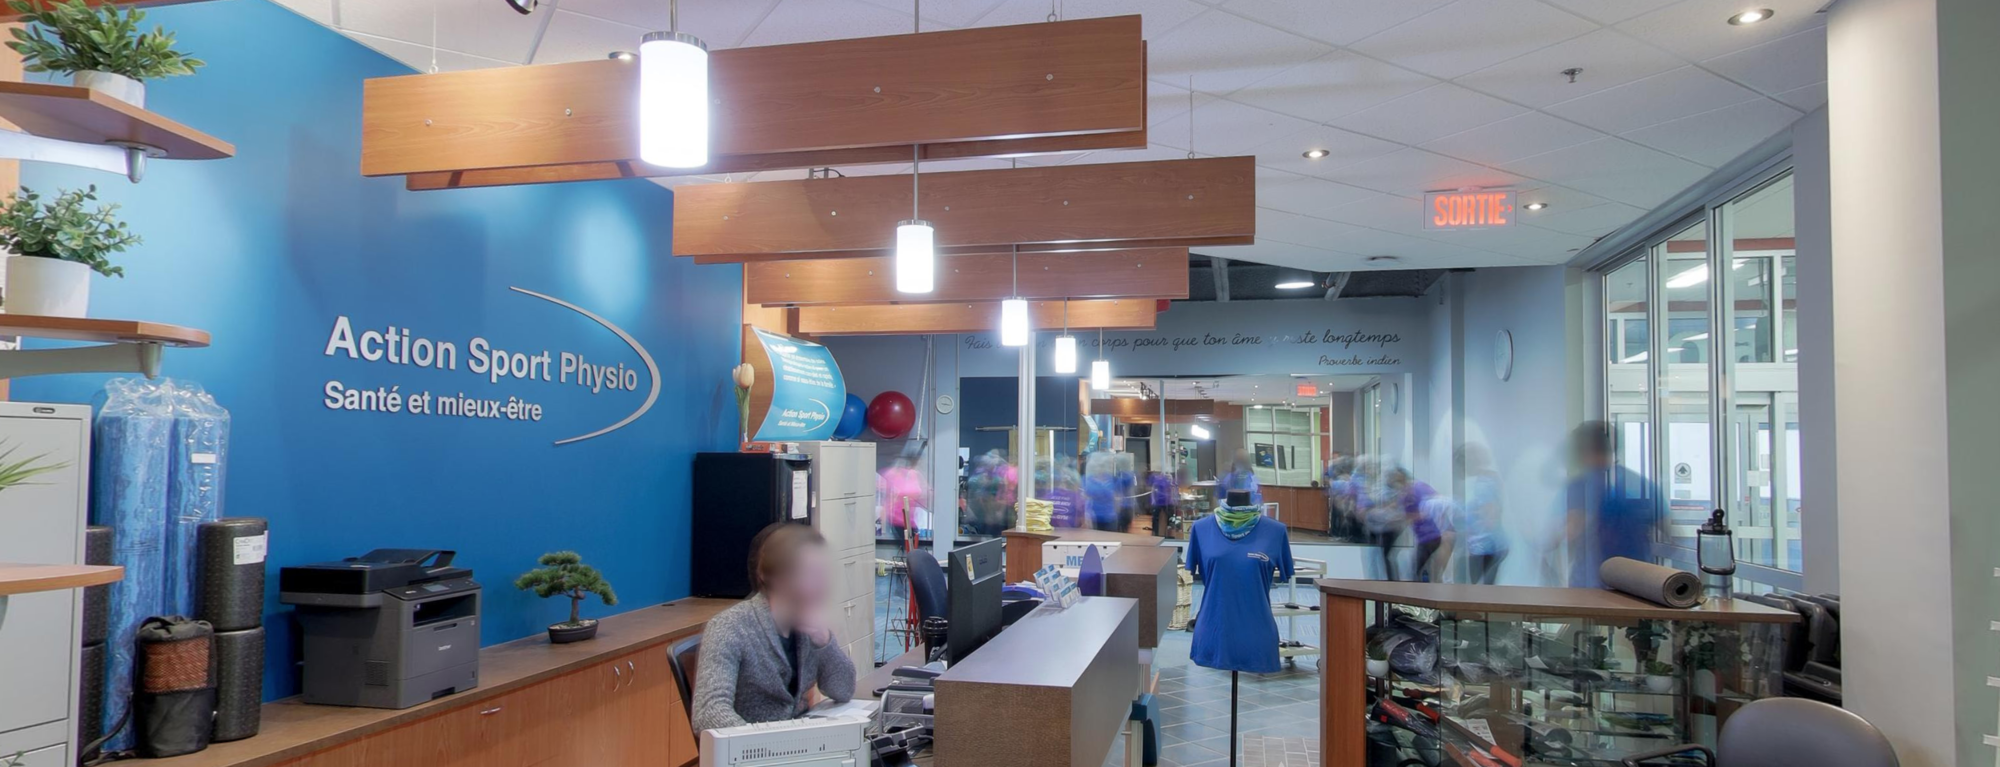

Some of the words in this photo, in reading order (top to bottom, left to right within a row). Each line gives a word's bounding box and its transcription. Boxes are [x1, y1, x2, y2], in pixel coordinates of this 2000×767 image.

[1434, 193, 1506, 226] SORTIE
[325, 315, 457, 370] Action
[468, 336, 551, 383] Sport
[560, 351, 638, 394] Physio
[964, 336, 992, 350] Fais
[1091, 337, 1130, 352] corps
[1131, 337, 1169, 352] pour
[1172, 337, 1199, 352] que
[1203, 332, 1227, 345] ton
[1231, 333, 1262, 345] âme
[1322, 328, 1401, 350] longtemps
[1318, 354, 1364, 366] Proverbe
[1366, 354, 1401, 366] indien
[324, 380, 402, 413] Santé
[408, 390, 431, 415] et
[437, 391, 543, 422] mieux-être
